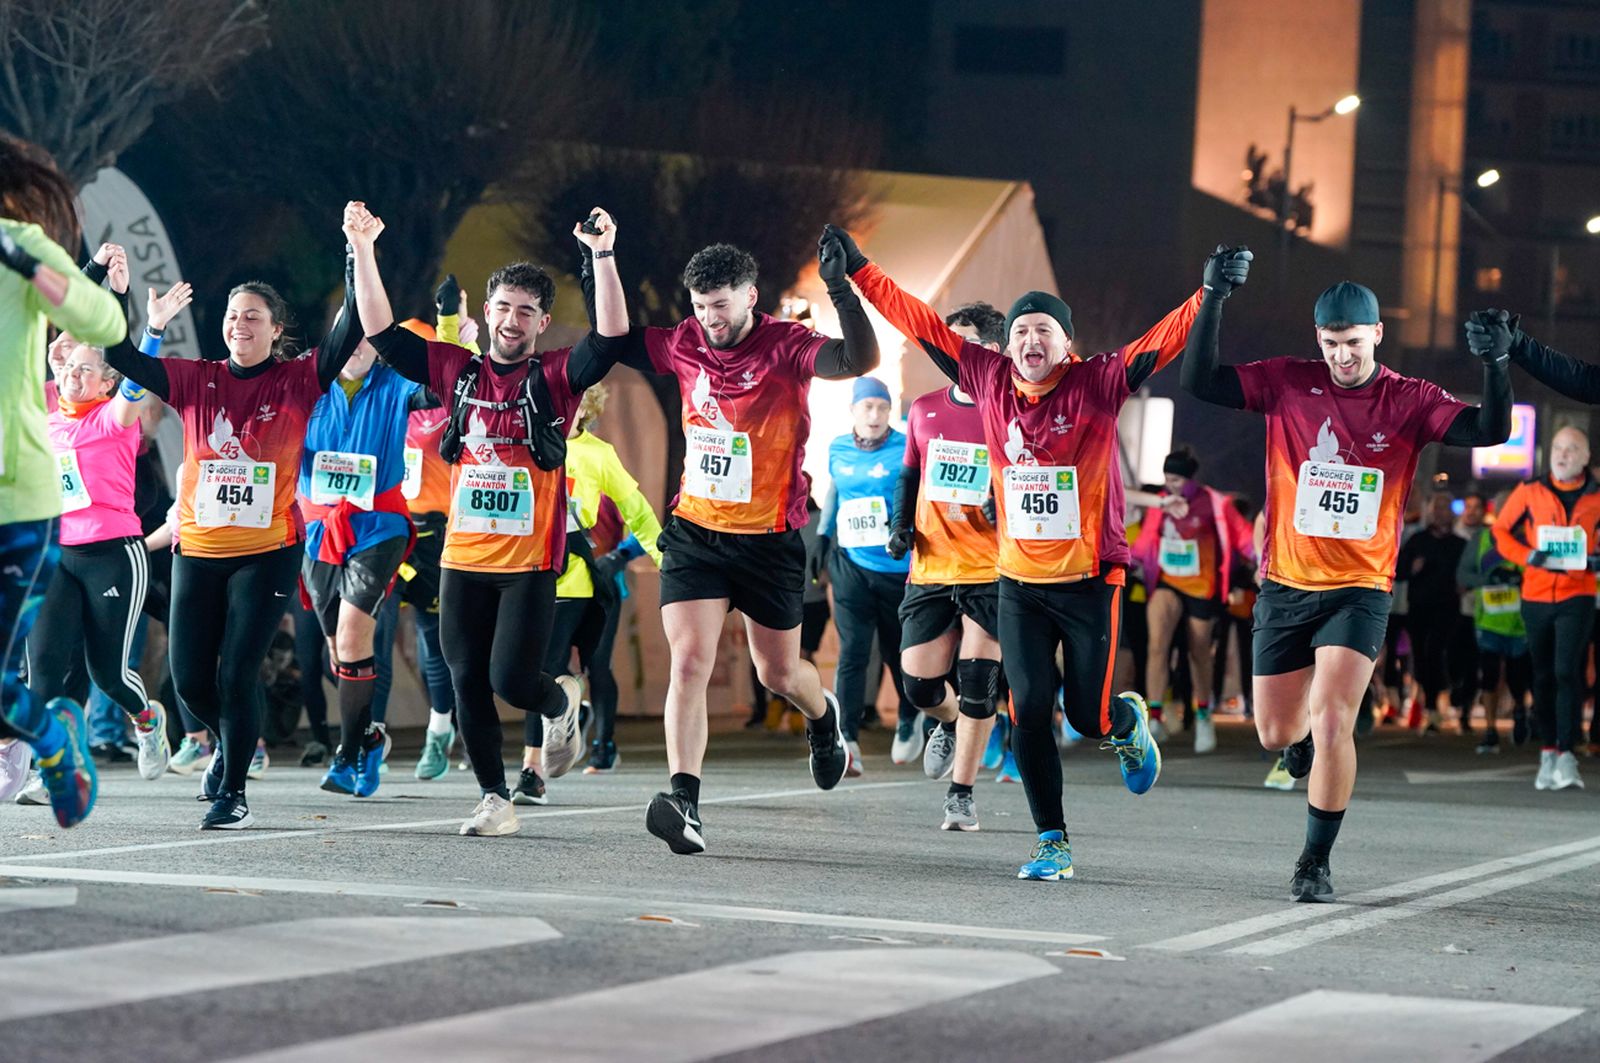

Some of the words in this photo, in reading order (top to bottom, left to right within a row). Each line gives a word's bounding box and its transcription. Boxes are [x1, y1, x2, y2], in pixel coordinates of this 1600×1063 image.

[701, 401, 718, 421] 43
[220, 441, 240, 460] 43
[475, 443, 493, 463] 43
[700, 454, 732, 477] 457
[940, 462, 978, 483] 7927
[327, 472, 360, 491] 7877
[465, 480, 480, 488] SAN
[1018, 474, 1039, 482] NOCHE
[1040, 474, 1049, 482] DE
[1308, 478, 1325, 487] SAN
[1318, 471, 1344, 480] NOCHE
[1344, 473, 1354, 481] DE
[216, 484, 254, 506] 454
[471, 489, 520, 512] 8307
[1021, 493, 1059, 515] 456
[1318, 490, 1360, 514] 455
[848, 515, 877, 530] 1063
